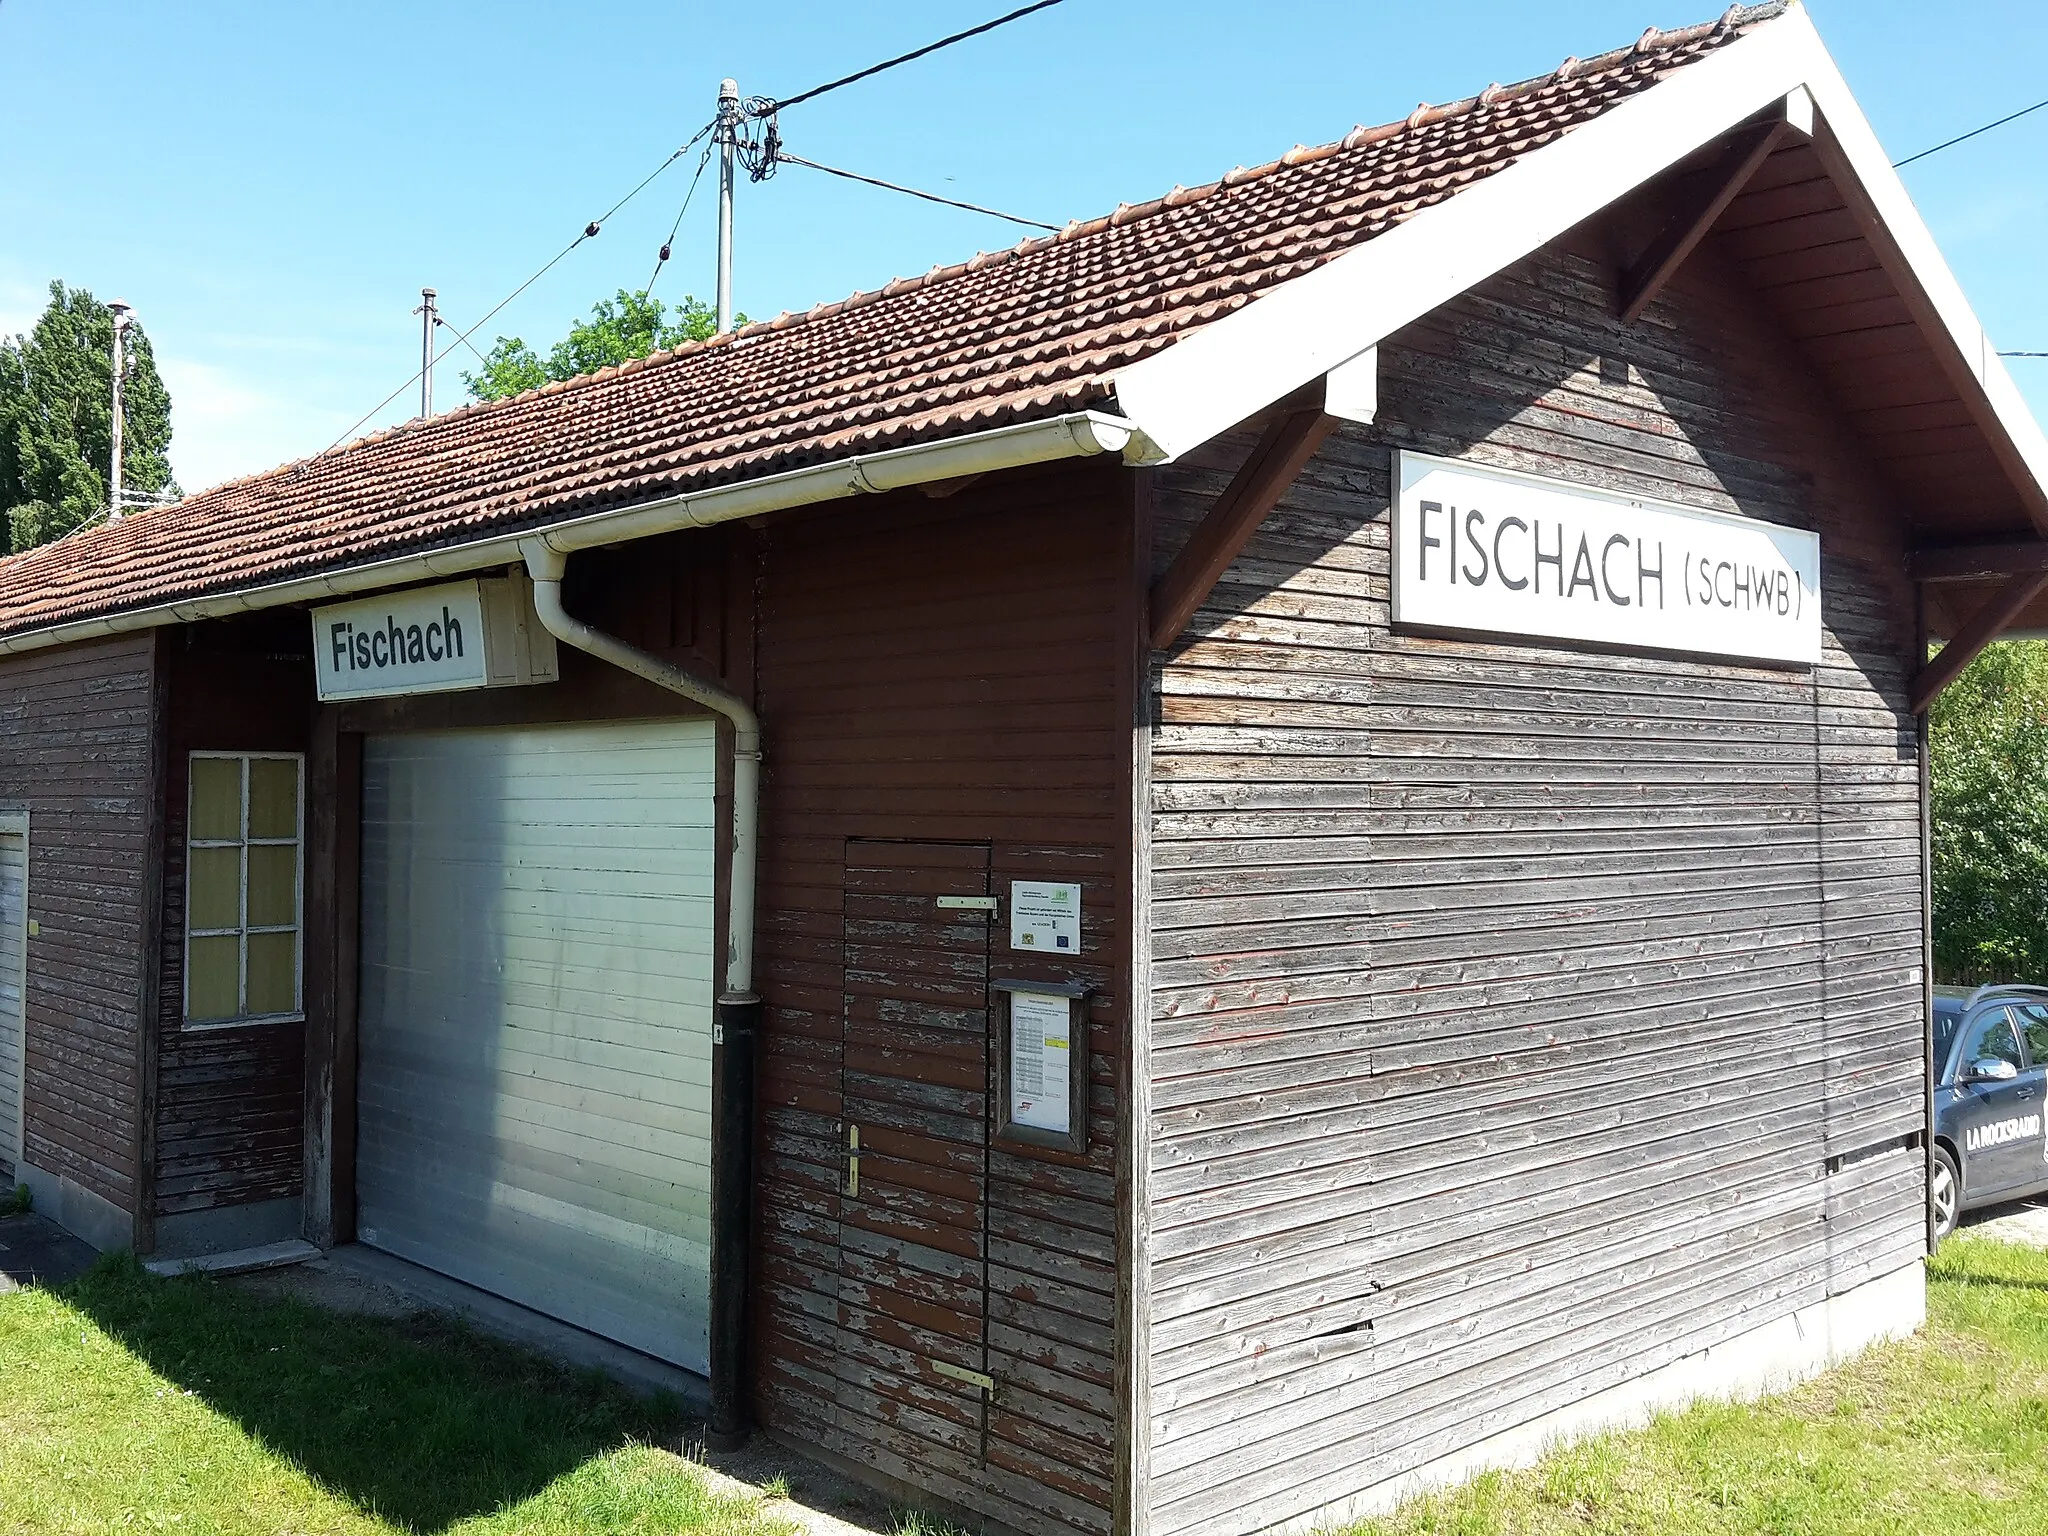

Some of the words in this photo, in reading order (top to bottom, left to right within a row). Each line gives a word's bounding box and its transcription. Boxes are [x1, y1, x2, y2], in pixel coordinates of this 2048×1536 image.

[1419, 500, 1664, 610] FISCHACH
[1684, 551, 1801, 620] (SCHWB)
[330, 606, 464, 672] Fischach
